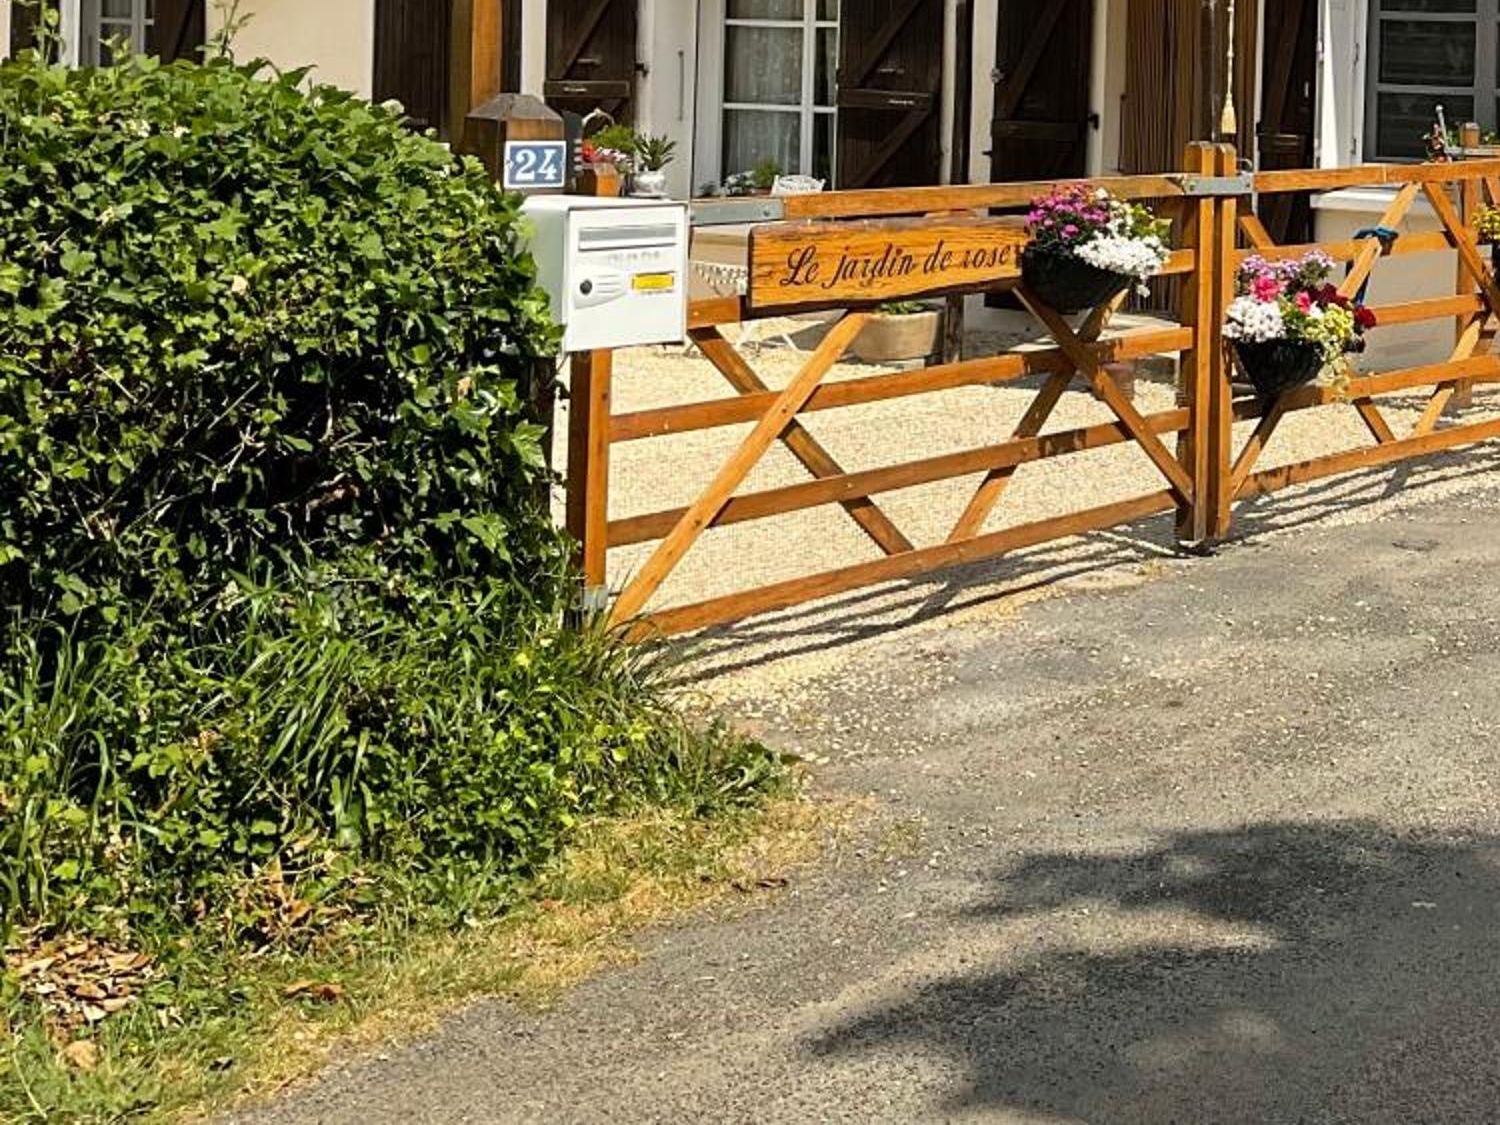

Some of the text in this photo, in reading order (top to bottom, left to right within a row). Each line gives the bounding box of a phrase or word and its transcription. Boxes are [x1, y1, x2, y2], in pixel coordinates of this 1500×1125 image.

[514, 148, 557, 181] 24
[779, 244, 819, 286] Le
[821, 242, 916, 289] jardin
[922, 239, 953, 274] de
